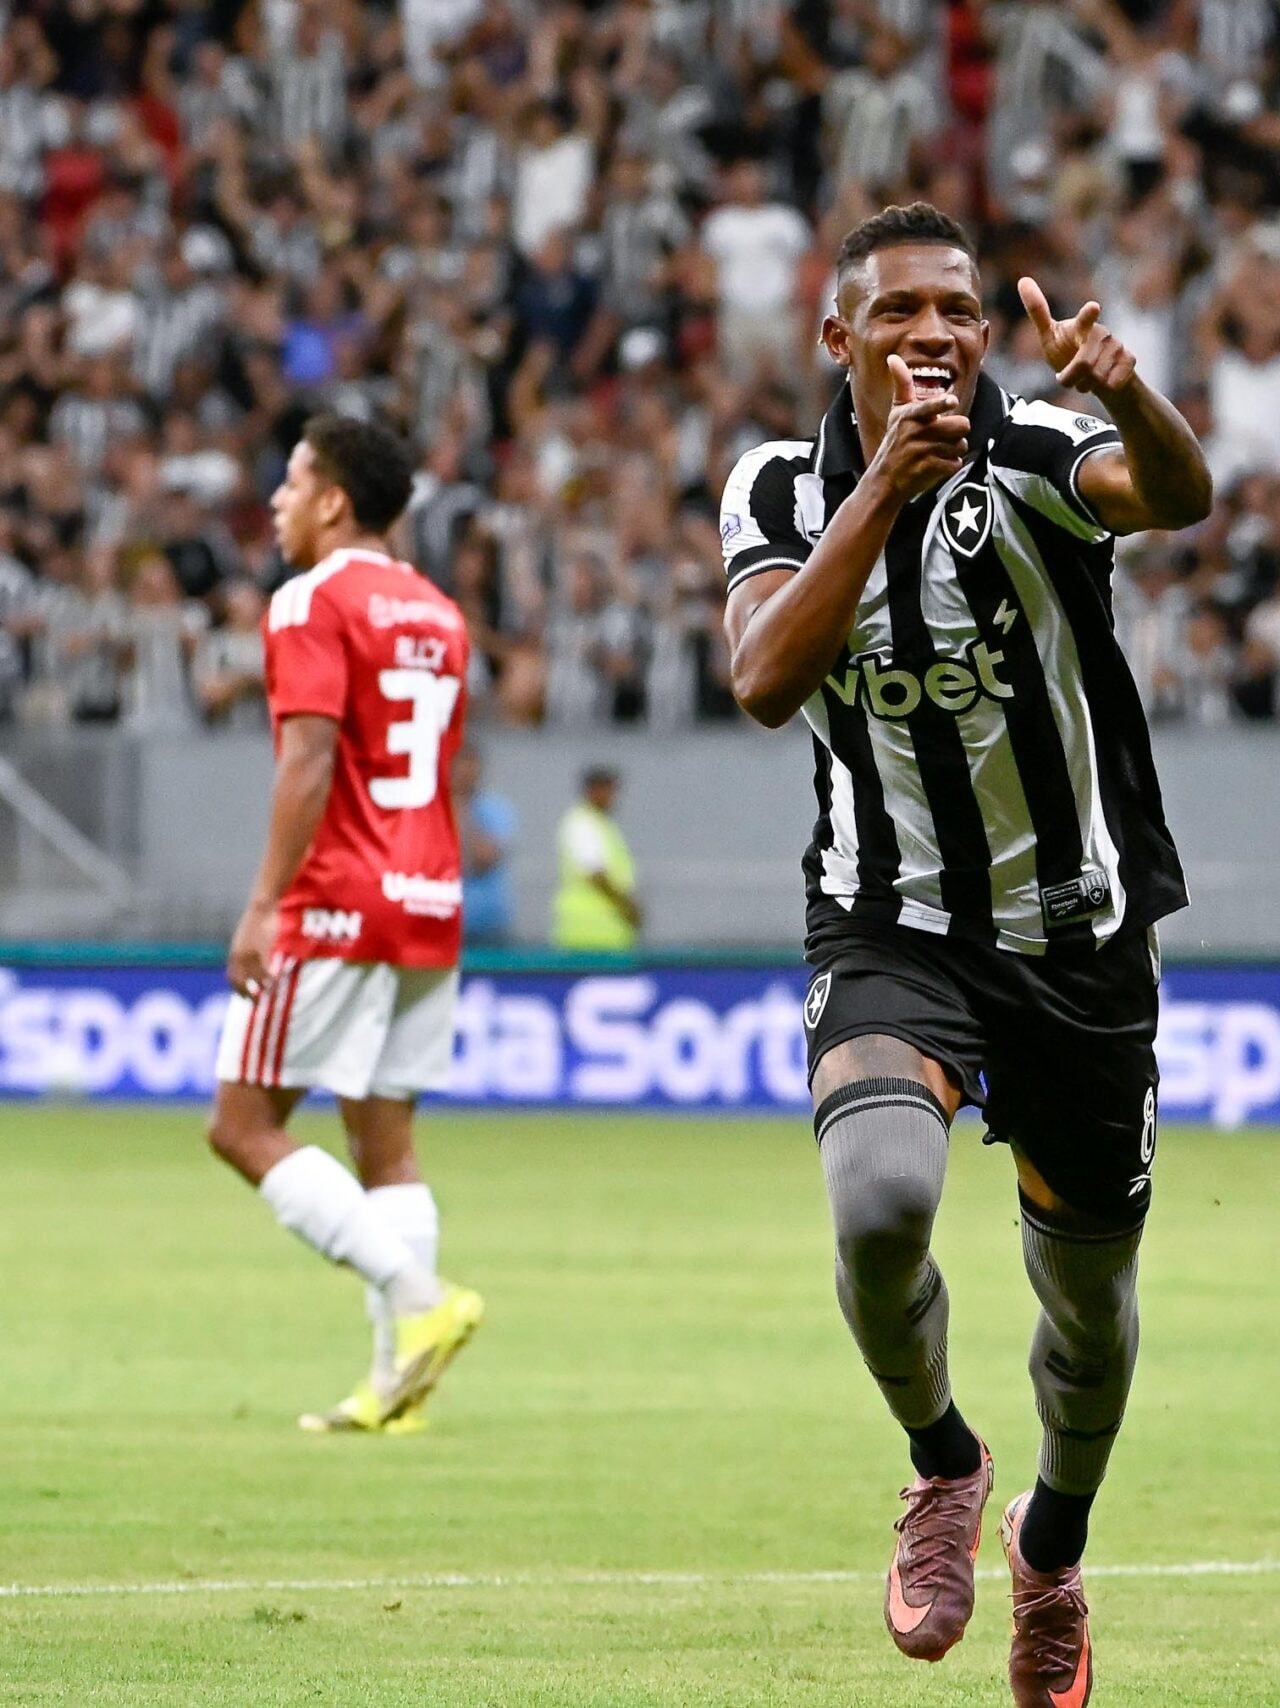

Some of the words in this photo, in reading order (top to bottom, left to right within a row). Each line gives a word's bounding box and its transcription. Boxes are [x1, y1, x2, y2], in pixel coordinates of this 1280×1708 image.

[824, 641, 1016, 718] vbet
[564, 974, 813, 1101] Sort
[1140, 1085, 1155, 1165] 8
